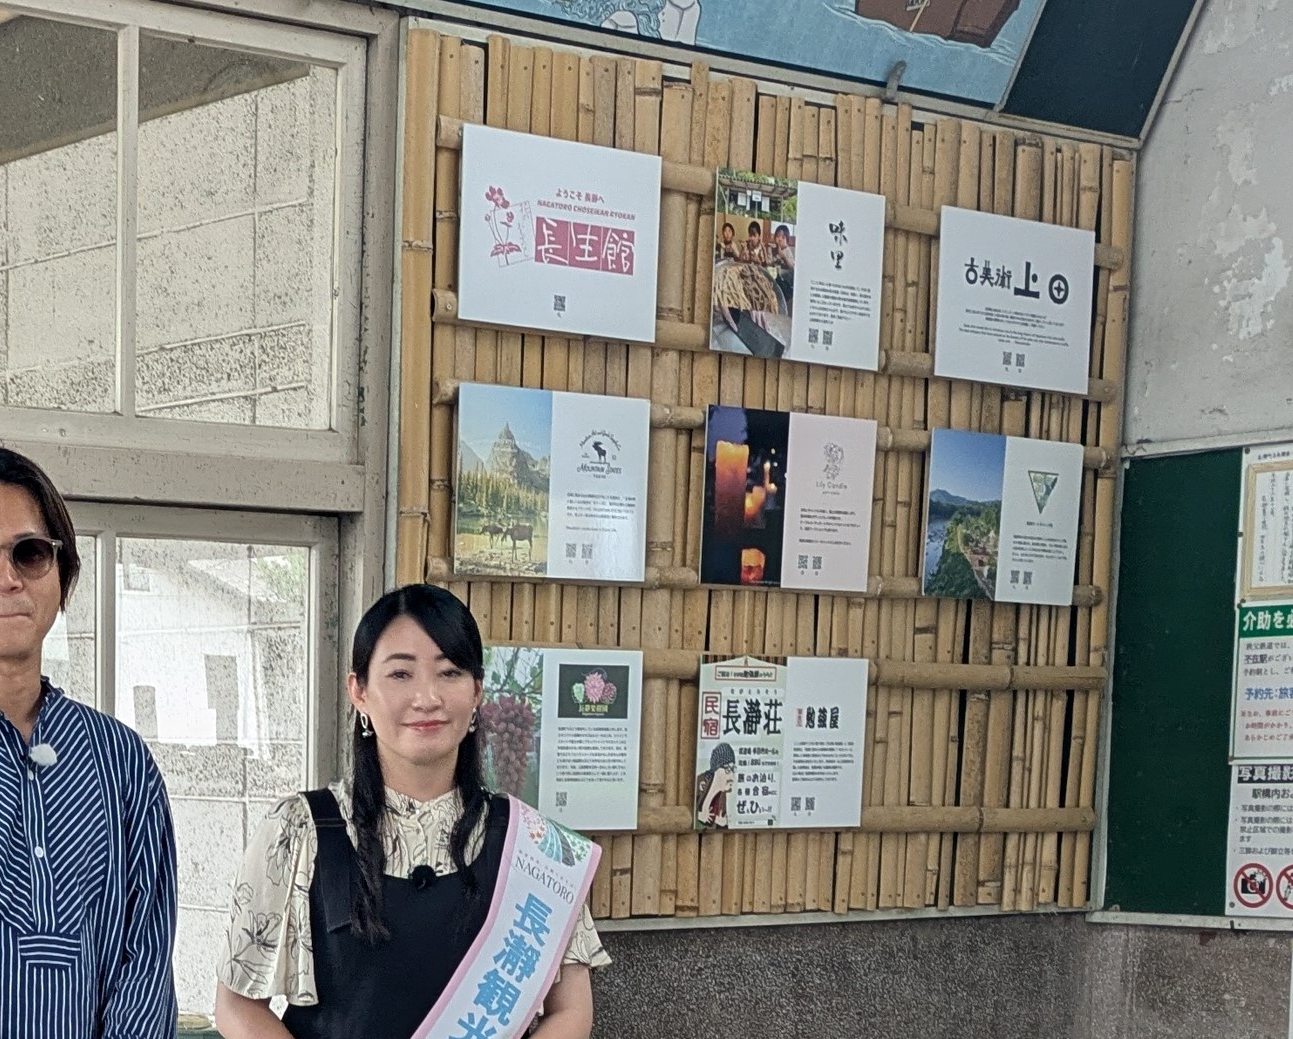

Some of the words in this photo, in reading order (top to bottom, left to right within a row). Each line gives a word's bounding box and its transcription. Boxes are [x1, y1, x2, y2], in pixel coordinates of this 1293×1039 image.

[537, 217, 634, 272] 長生館
[703, 695, 719, 736] 民宿
[1252, 788, 1293, 799] 駅構内お
[1238, 846, 1293, 855] 三脚および脚立等
[514, 856, 574, 905] NAGATORO
